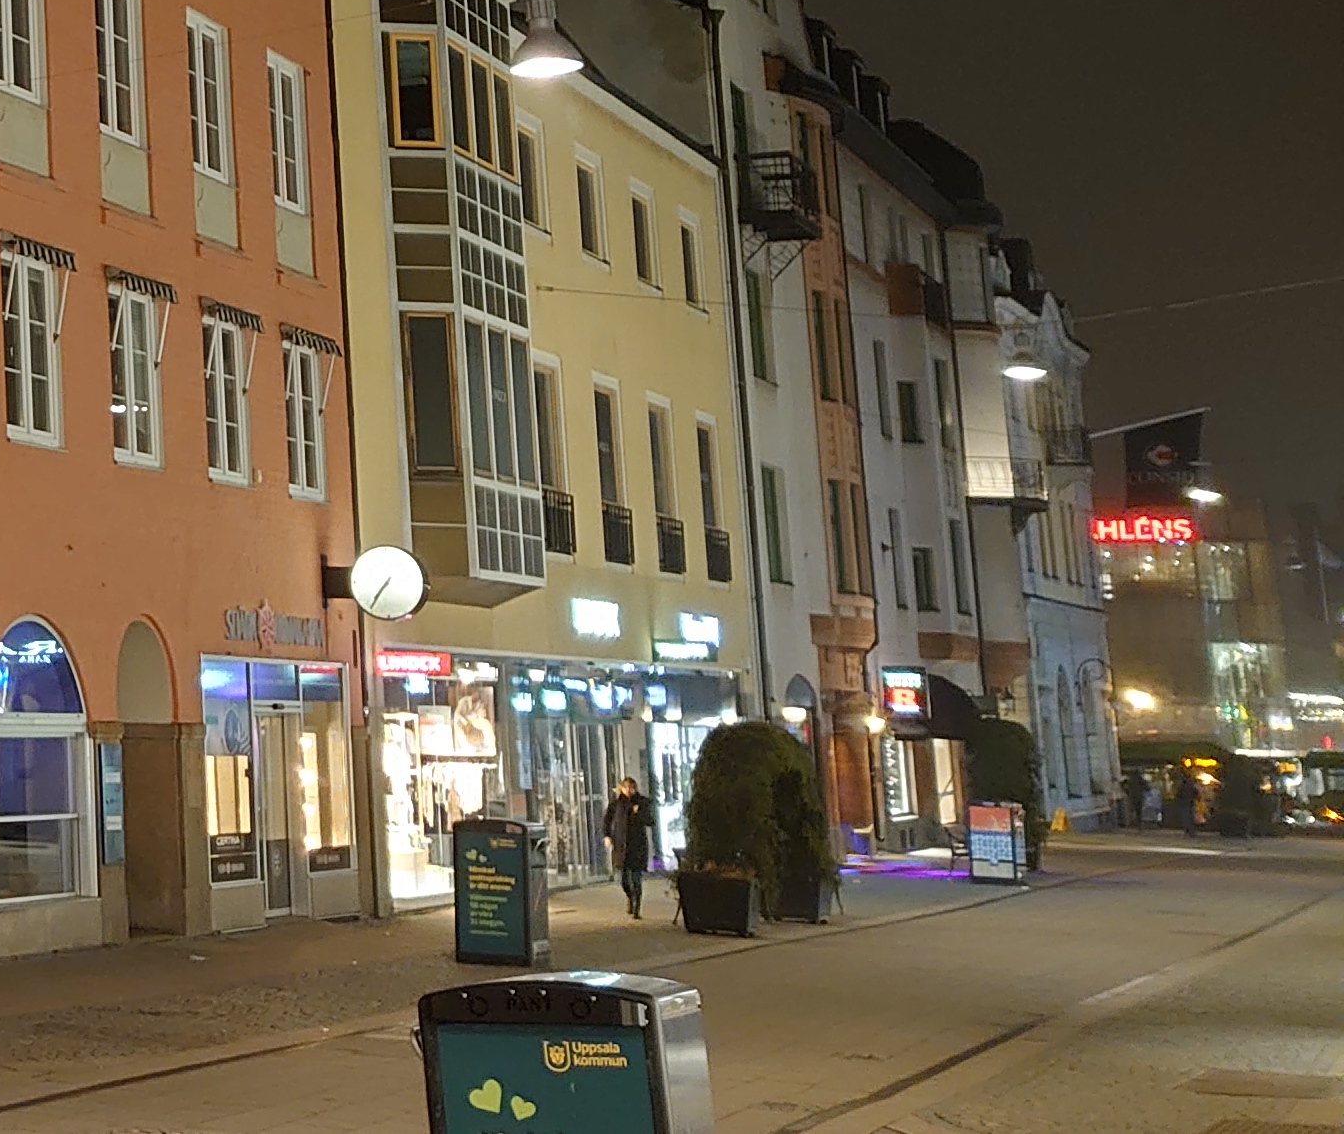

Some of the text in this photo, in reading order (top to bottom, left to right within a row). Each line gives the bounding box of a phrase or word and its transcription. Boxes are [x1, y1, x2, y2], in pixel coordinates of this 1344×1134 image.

[1093, 515, 1193, 541] HLÉNS
[572, 1041, 621, 1056] Uppsala
[573, 1054, 627, 1067] kommun
